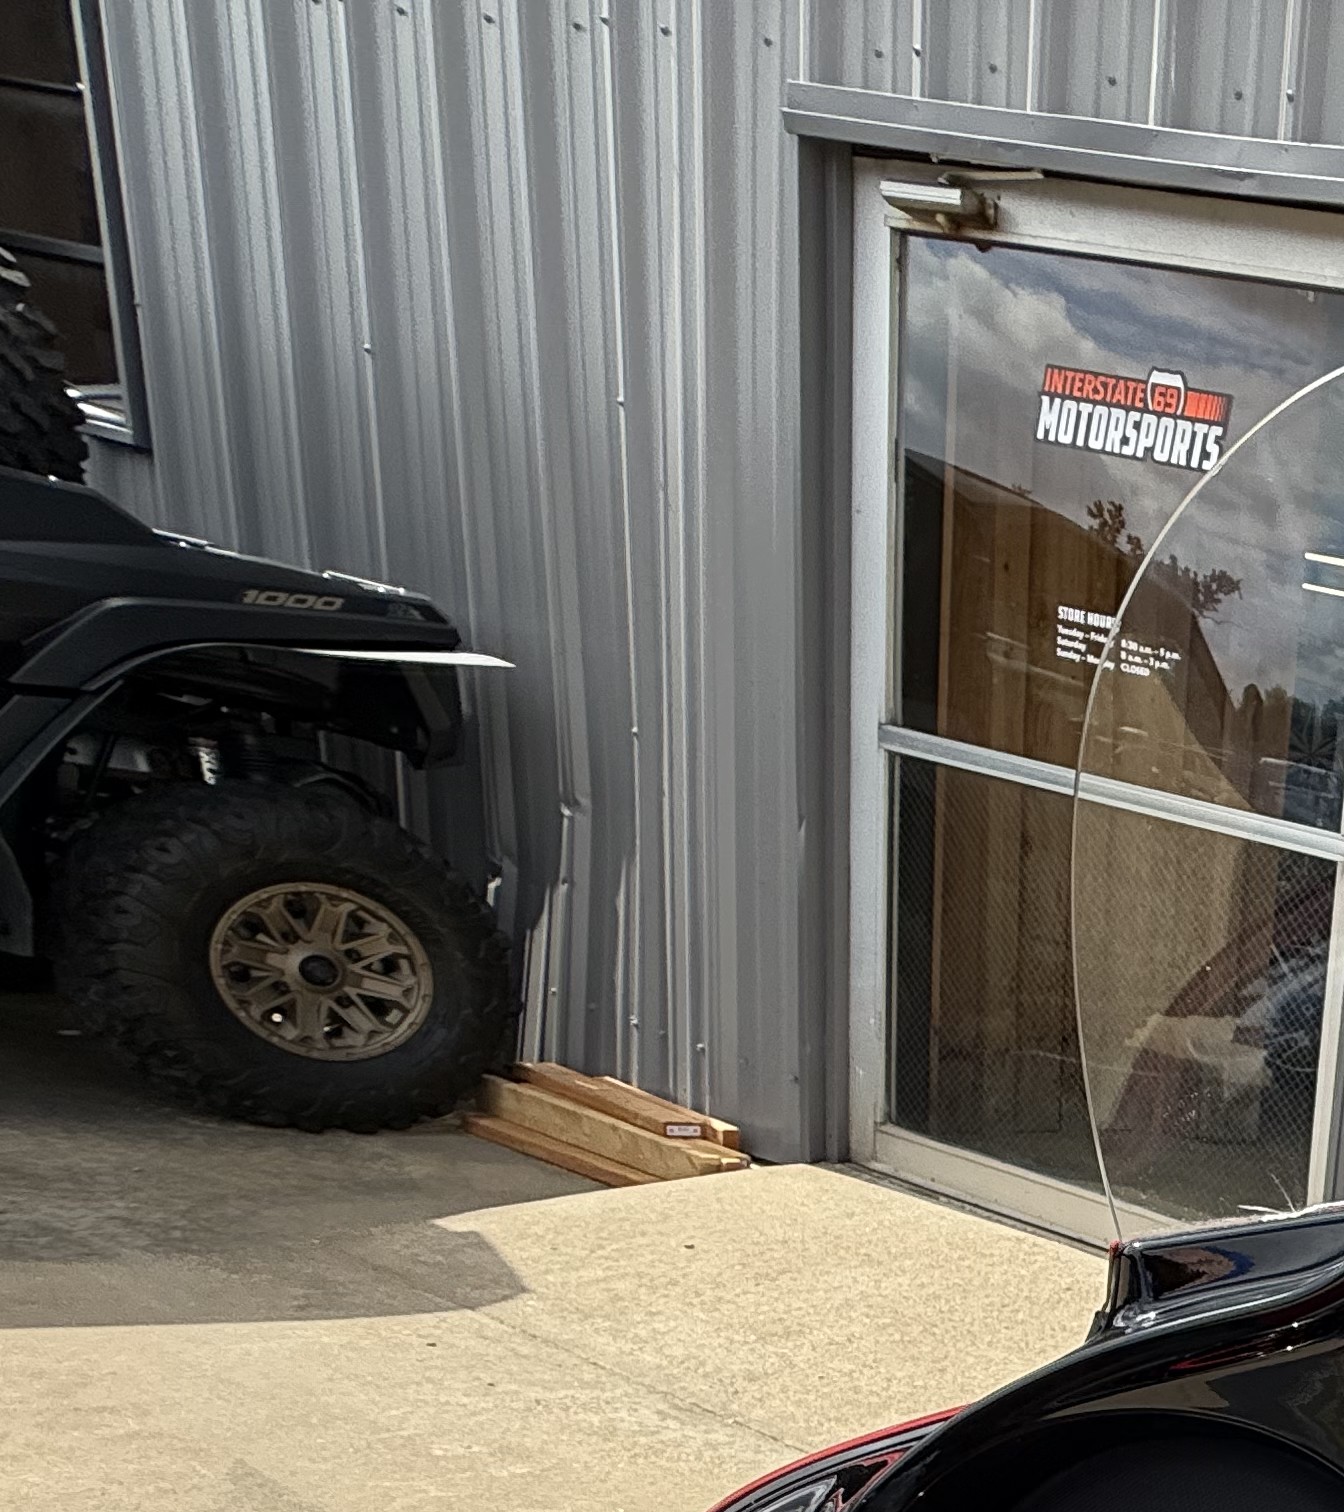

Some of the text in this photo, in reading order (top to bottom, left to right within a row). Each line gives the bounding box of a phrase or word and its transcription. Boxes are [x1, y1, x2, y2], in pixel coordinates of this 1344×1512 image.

[1044, 368, 1178, 414] INTERSTATE 69
[1037, 395, 1223, 471] MOTORSPORTS
[241, 589, 346, 611] 1000
[1058, 605, 1086, 625] STORE
[1120, 663, 1150, 677] CLOSED
